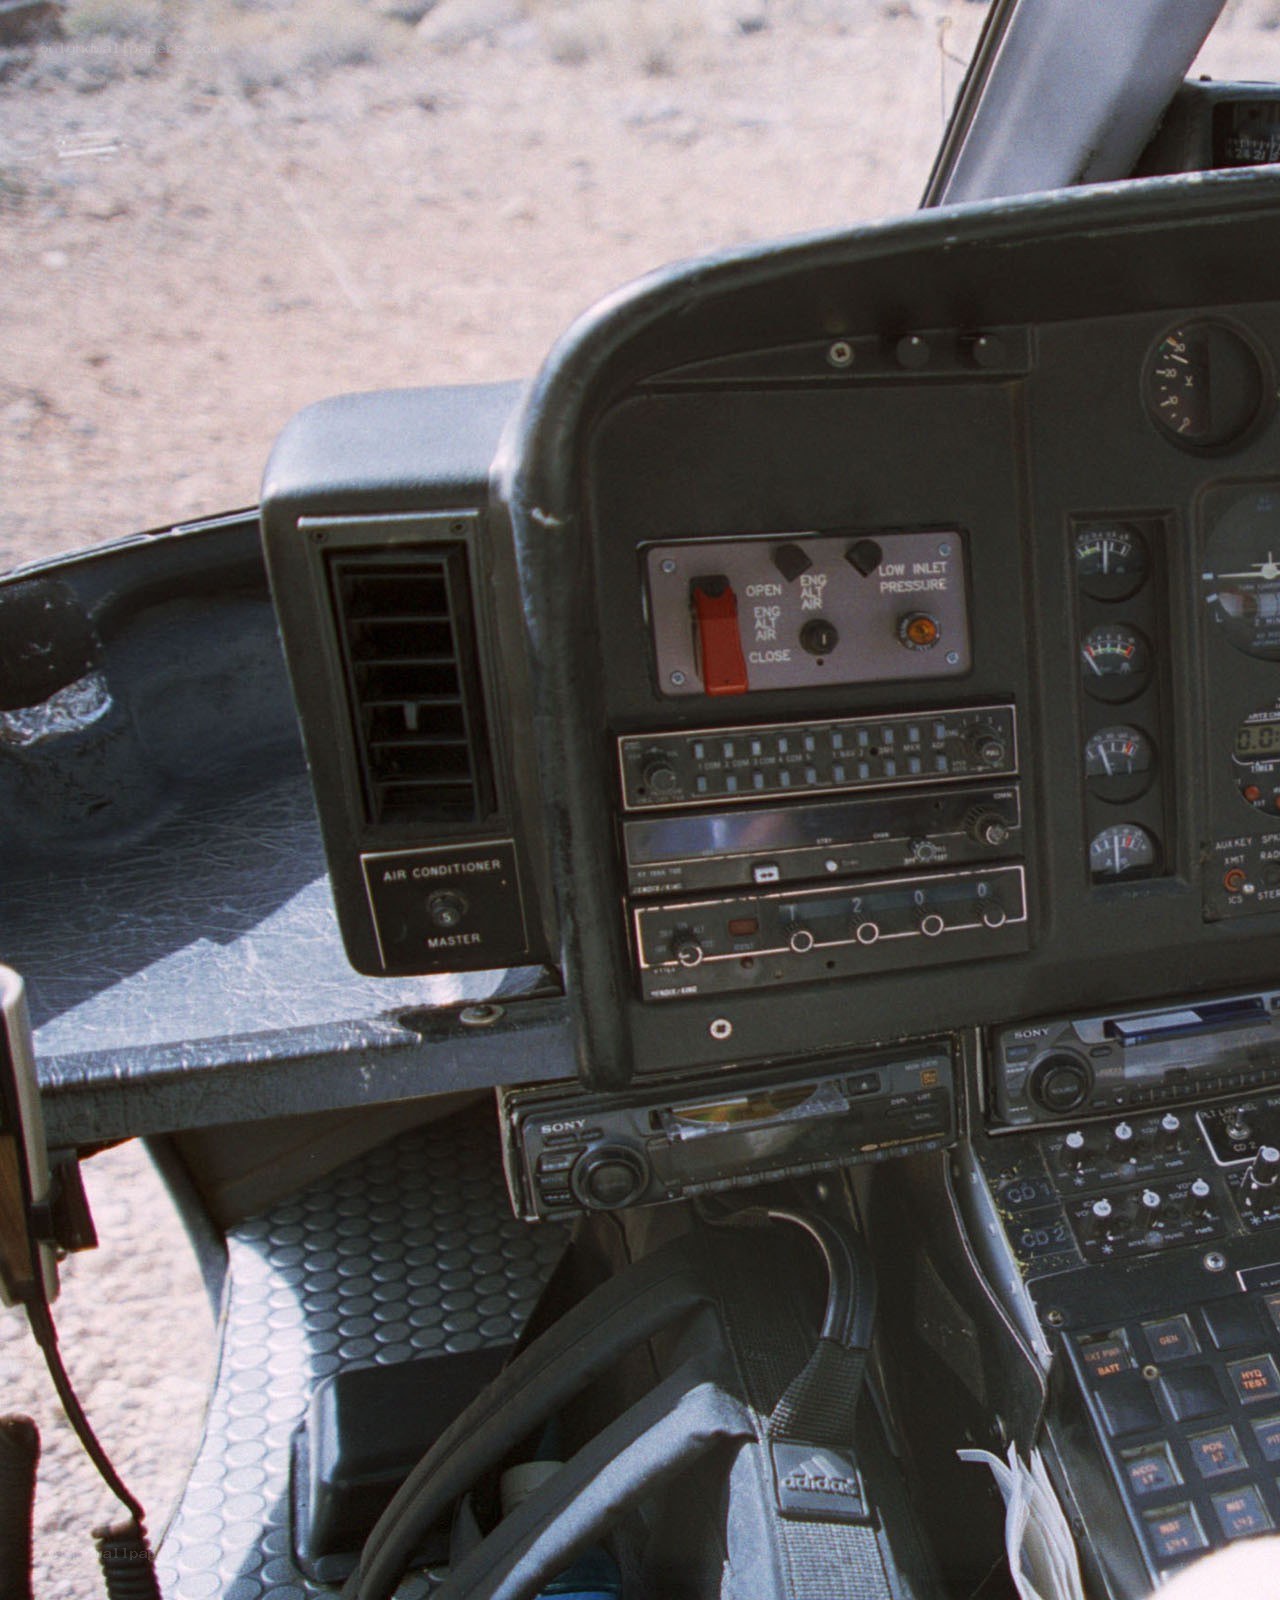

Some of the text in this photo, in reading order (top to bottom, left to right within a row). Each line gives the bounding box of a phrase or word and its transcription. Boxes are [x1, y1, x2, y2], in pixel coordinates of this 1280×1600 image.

[877, 560, 947, 577] LOW INLET
[801, 573, 828, 588] ENG
[879, 577, 947, 594] PRESSURE
[745, 583, 783, 598] OPEN
[801, 587, 825, 599] ALT
[801, 598, 824, 610] AIR
[754, 605, 780, 618] ENG
[754, 618, 777, 630] ALT
[755, 629, 777, 642] AIR
[749, 649, 792, 664] CLOSE
[704, 761, 721, 770] COM
[731, 759, 749, 768] COM
[759, 757, 776, 766] COM
[786, 754, 802, 763] COM
[1215, 837, 1252, 850] AUX KEY
[1224, 855, 1245, 865] XMIT
[382, 857, 502, 883] AIR CONDITIONER
[851, 896, 863, 914] 2
[913, 889, 926, 906] 0
[977, 881, 989, 898] 0
[1228, 896, 1243, 904] ICS
[427, 932, 481, 950] MASTER
[1014, 1028, 1050, 1040] SONY
[541, 1120, 586, 1134] SONY
[1232, 1141, 1258, 1153] CD 2
[1007, 1182, 1050, 1203] CD 1
[1021, 1226, 1068, 1249] CD 2
[1159, 1334, 1179, 1346] GEN
[1084, 1347, 1120, 1362] EXT PWR
[1097, 1363, 1120, 1377] BATT
[1241, 1368, 1262, 1380] HYD
[1242, 1378, 1268, 1390] TEST
[780, 1475, 857, 1495] adidas
